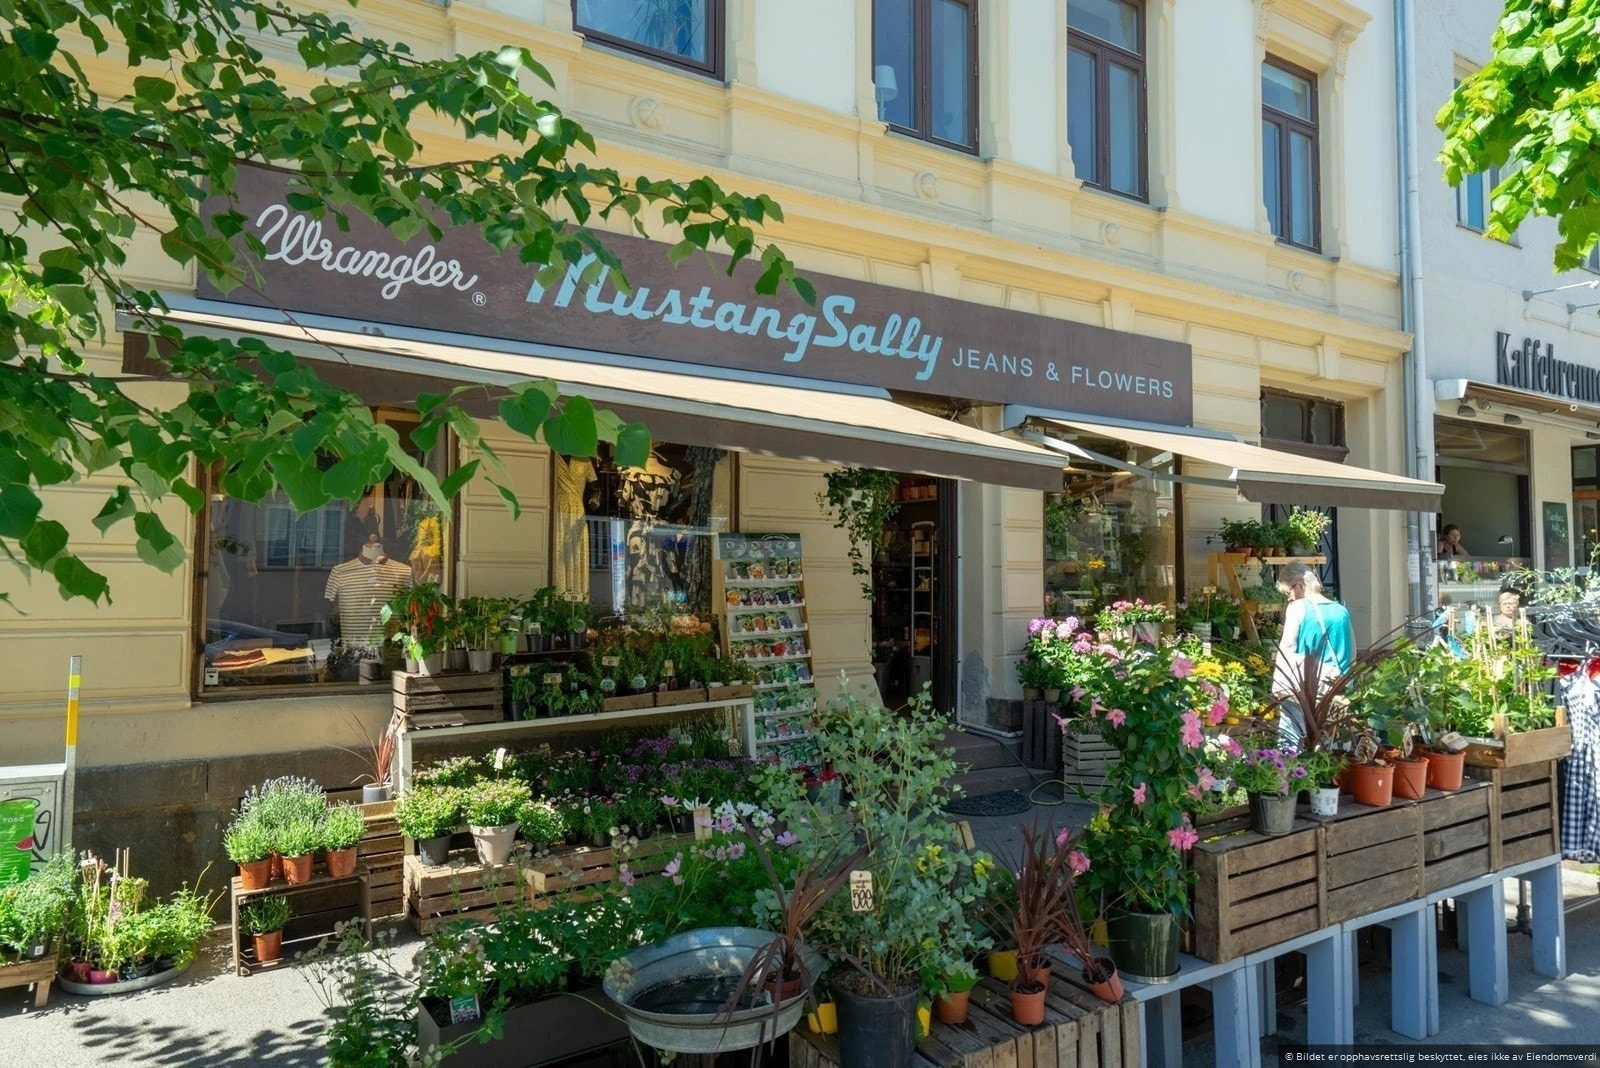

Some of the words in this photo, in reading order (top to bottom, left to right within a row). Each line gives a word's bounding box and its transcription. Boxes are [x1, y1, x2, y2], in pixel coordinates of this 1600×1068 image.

[256, 204, 478, 300] Wrangler
[952, 347, 1033, 377] JEANS
[1046, 362, 1059, 381] &
[1071, 365, 1173, 398] FLOWERS
[1496, 331, 1600, 403] Kaffebrenn
[2, 816, 25, 824] TORG
